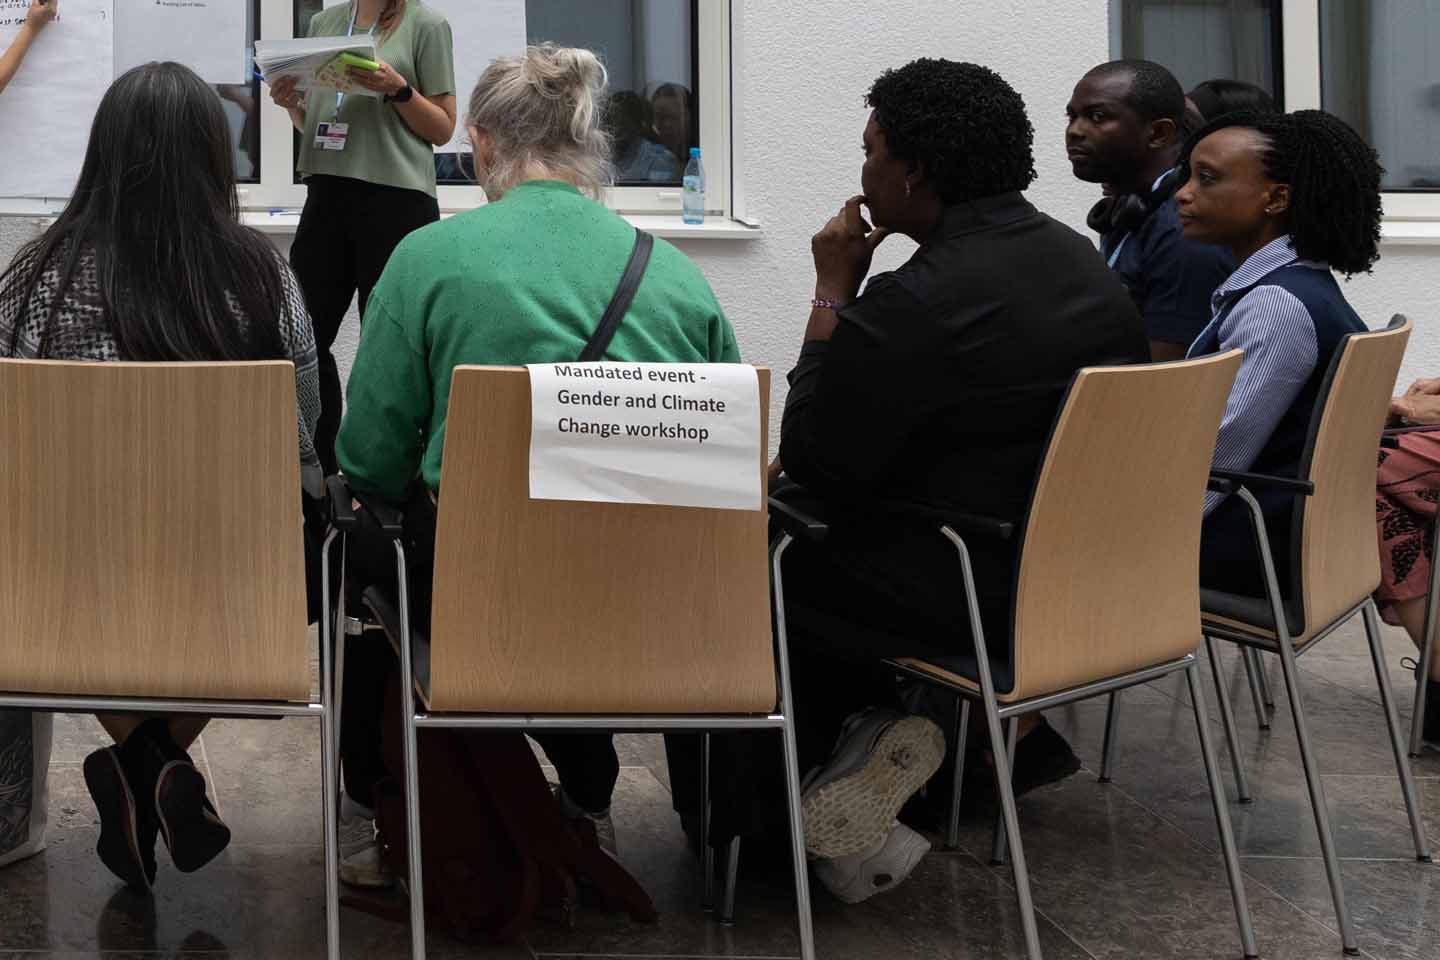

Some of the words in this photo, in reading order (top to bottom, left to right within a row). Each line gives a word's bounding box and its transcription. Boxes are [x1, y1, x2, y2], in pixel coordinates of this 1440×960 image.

[554, 365, 643, 381] Mandated
[648, 370, 696, 383] event
[557, 389, 620, 407] Gender
[625, 393, 657, 409] and
[662, 394, 726, 413] Climate
[558, 417, 620, 438] Change
[625, 421, 709, 443] workshop
